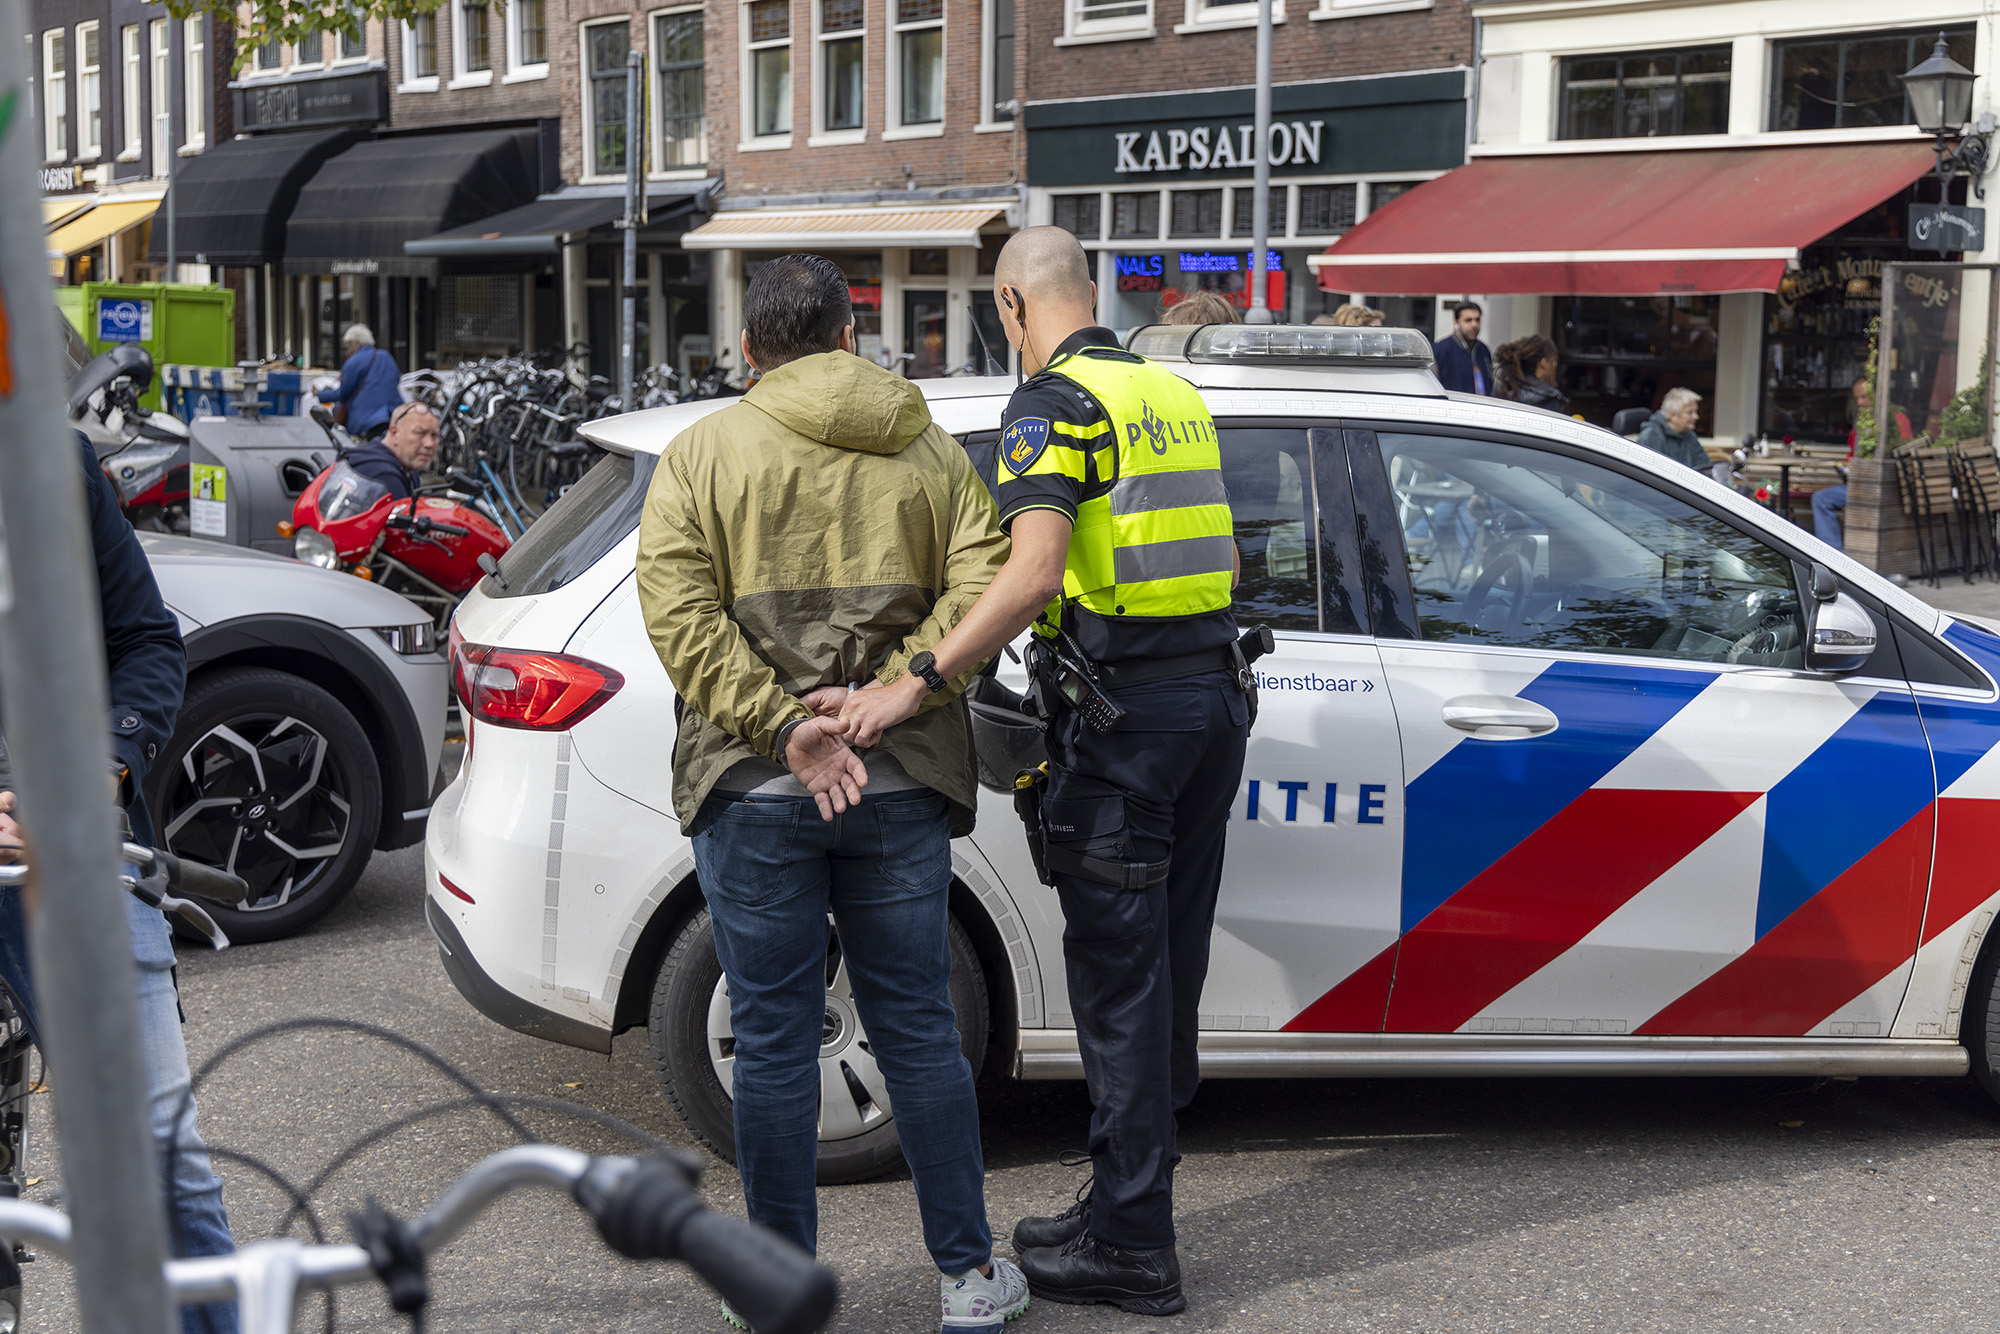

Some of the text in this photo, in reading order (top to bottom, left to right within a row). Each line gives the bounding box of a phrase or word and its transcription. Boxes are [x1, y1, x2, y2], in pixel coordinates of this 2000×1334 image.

[1115, 121, 1325, 173] KAPSALON
[1005, 425, 1045, 440] POLITIE
[1246, 780, 1387, 825] ITIE
